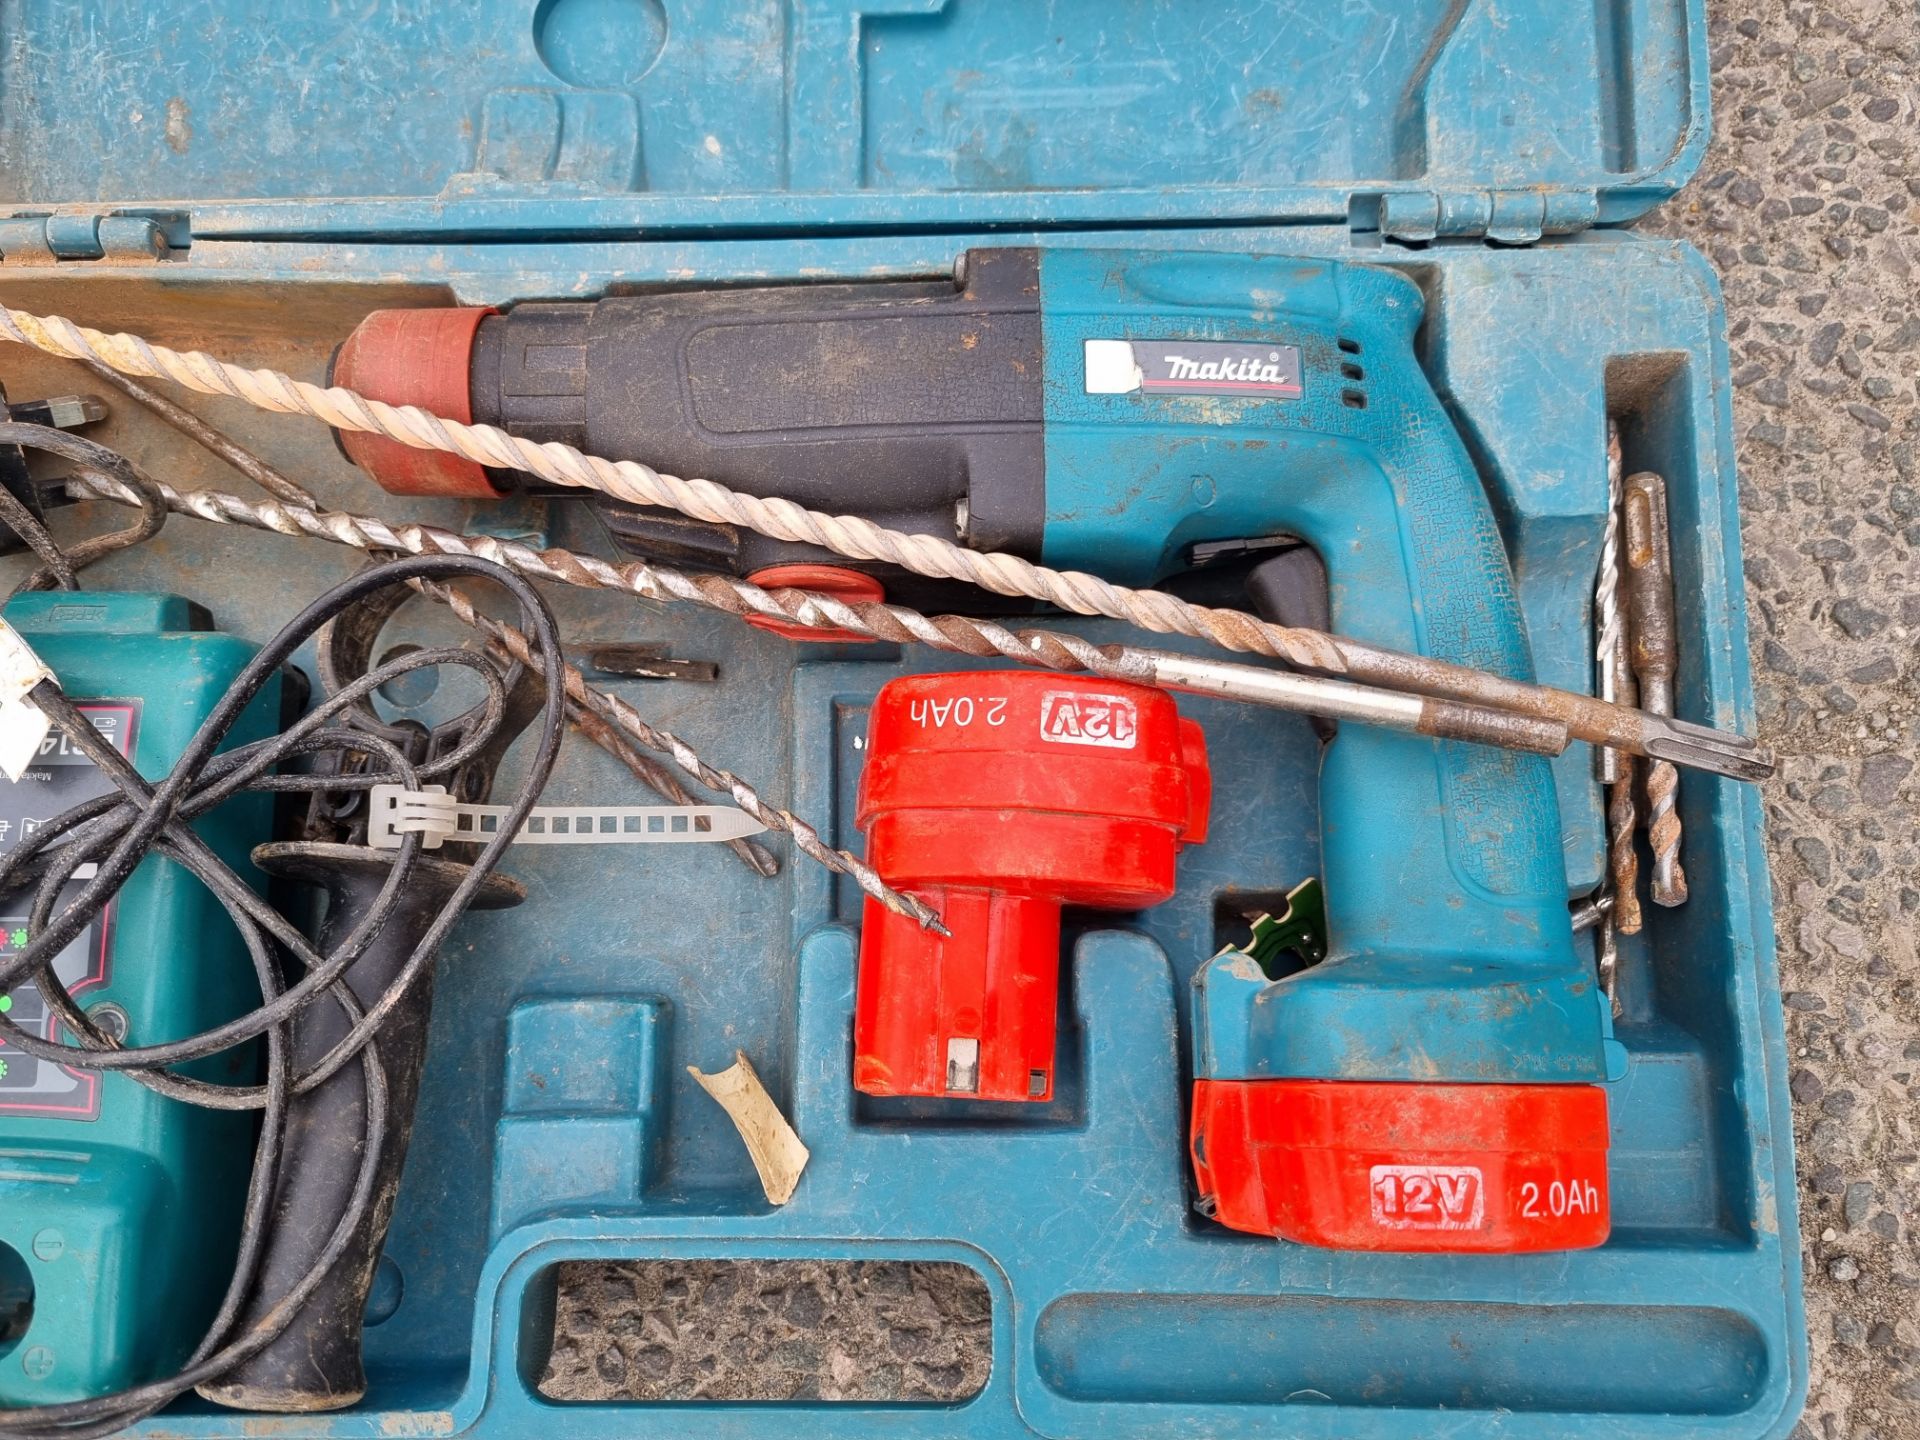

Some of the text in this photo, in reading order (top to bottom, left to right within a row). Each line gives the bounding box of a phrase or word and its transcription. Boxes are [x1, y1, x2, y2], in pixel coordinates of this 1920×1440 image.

[910, 696, 1134, 740] 12V 2.0Ah
[1374, 1175, 1599, 1219] 12V 2.0Ah
